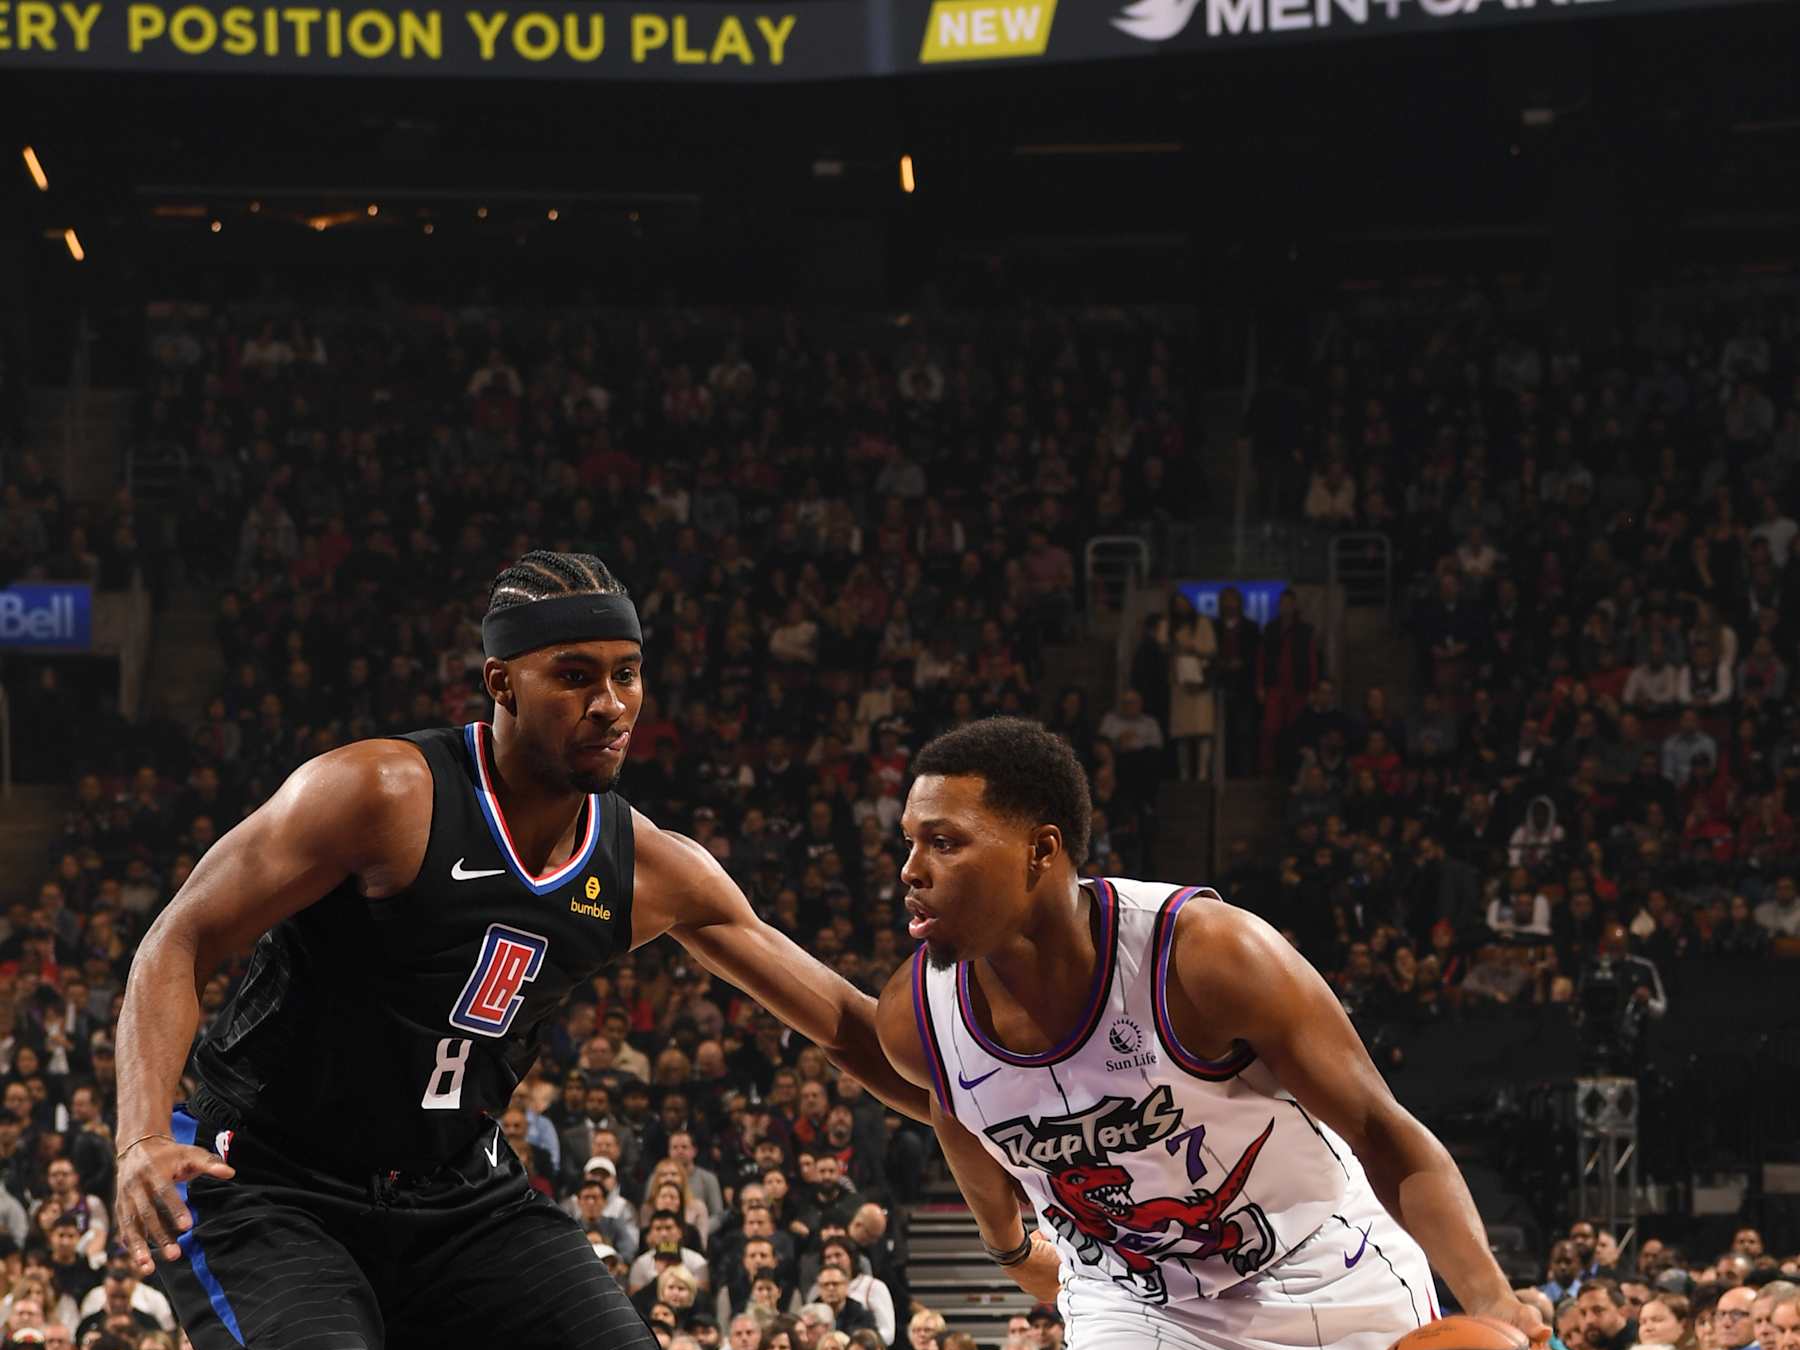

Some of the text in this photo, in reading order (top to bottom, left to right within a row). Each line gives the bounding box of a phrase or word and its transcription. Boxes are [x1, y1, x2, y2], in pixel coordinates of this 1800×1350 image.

[127, 5, 442, 59] POSITION
[466, 11, 605, 62] YOU
[630, 14, 796, 65] PLAY
[939, 7, 1041, 47] NEW
[0, 593, 75, 639] Bell
[570, 896, 611, 920] bumble
[421, 1037, 473, 1109] 8
[1105, 1052, 1157, 1072] Sun Life
[1166, 1125, 1207, 1184] 7
